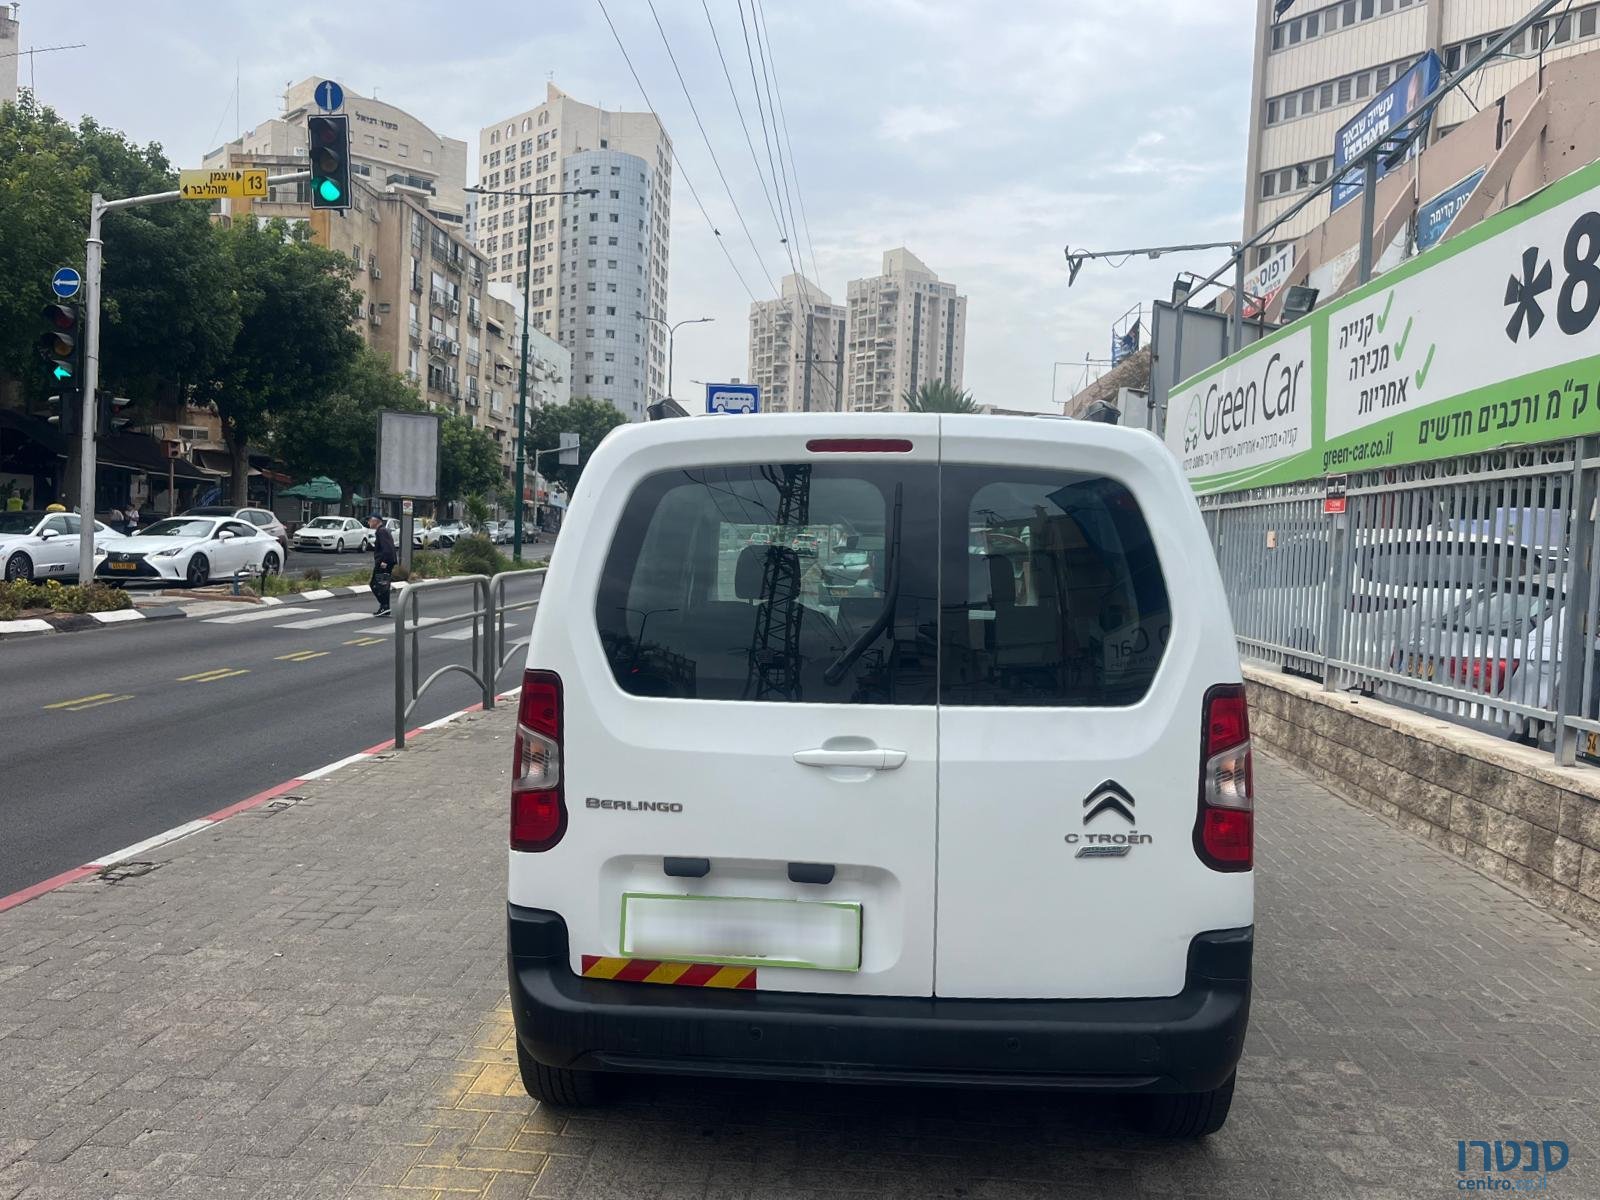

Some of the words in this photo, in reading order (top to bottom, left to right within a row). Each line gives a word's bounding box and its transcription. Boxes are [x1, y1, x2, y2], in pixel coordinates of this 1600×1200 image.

[1367, 92, 1394, 127] עשייה
[1342, 116, 1367, 148] שבאה
[190, 182, 227, 194] מוהליבר
[210, 171, 234, 184] ויצמן
[248, 176, 262, 190] 13
[1429, 201, 1454, 226] קדימה
[1260, 253, 1287, 287] דפוס
[1339, 313, 1374, 350] קנייה
[1349, 344, 1390, 381] מכירה
[1204, 381, 1257, 440] Green
[1262, 353, 1304, 420] Car
[1358, 376, 1409, 415] אחריות
[1418, 410, 1473, 445] חדשים
[1477, 394, 1540, 433] ורכבים
[1260, 432, 1278, 450] מכירה
[1282, 427, 1298, 448] קניה
[1323, 431, 1394, 472] green-car.co.il
[585, 797, 683, 813] BERLINGO
